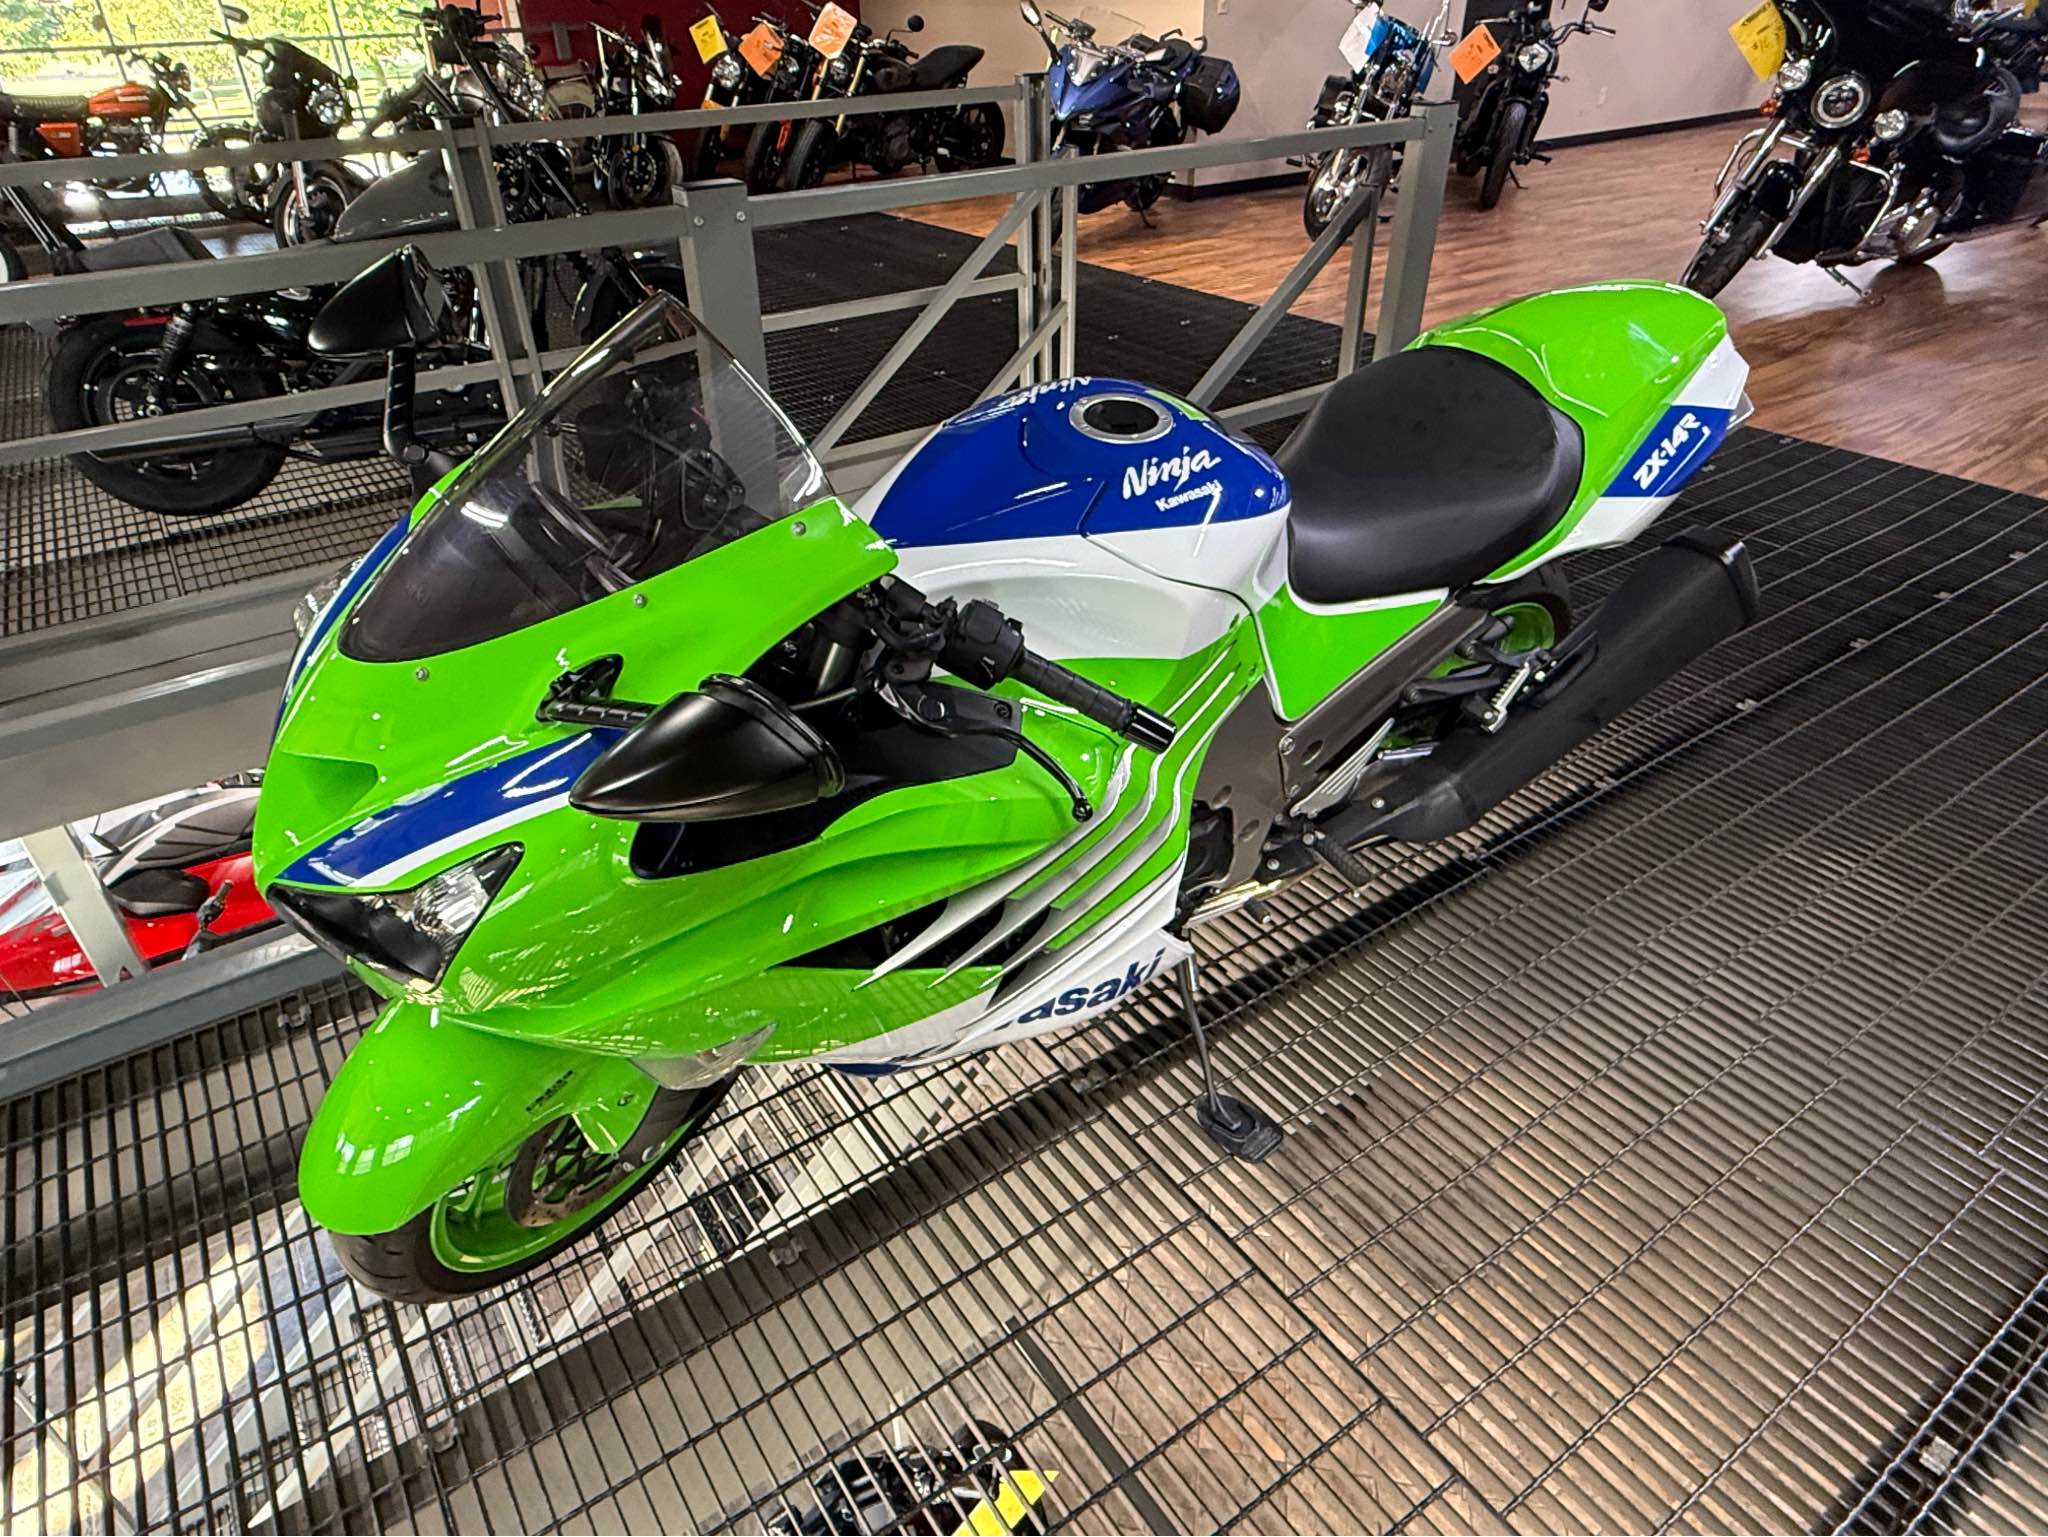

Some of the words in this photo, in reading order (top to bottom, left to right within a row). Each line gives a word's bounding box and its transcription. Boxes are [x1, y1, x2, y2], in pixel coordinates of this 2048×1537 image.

[1122, 445, 1222, 500] Ninja
[1633, 413, 1702, 490] ZX-14R
[1154, 479, 1224, 512] Kawasaki
[991, 947, 1167, 1030] asaki
